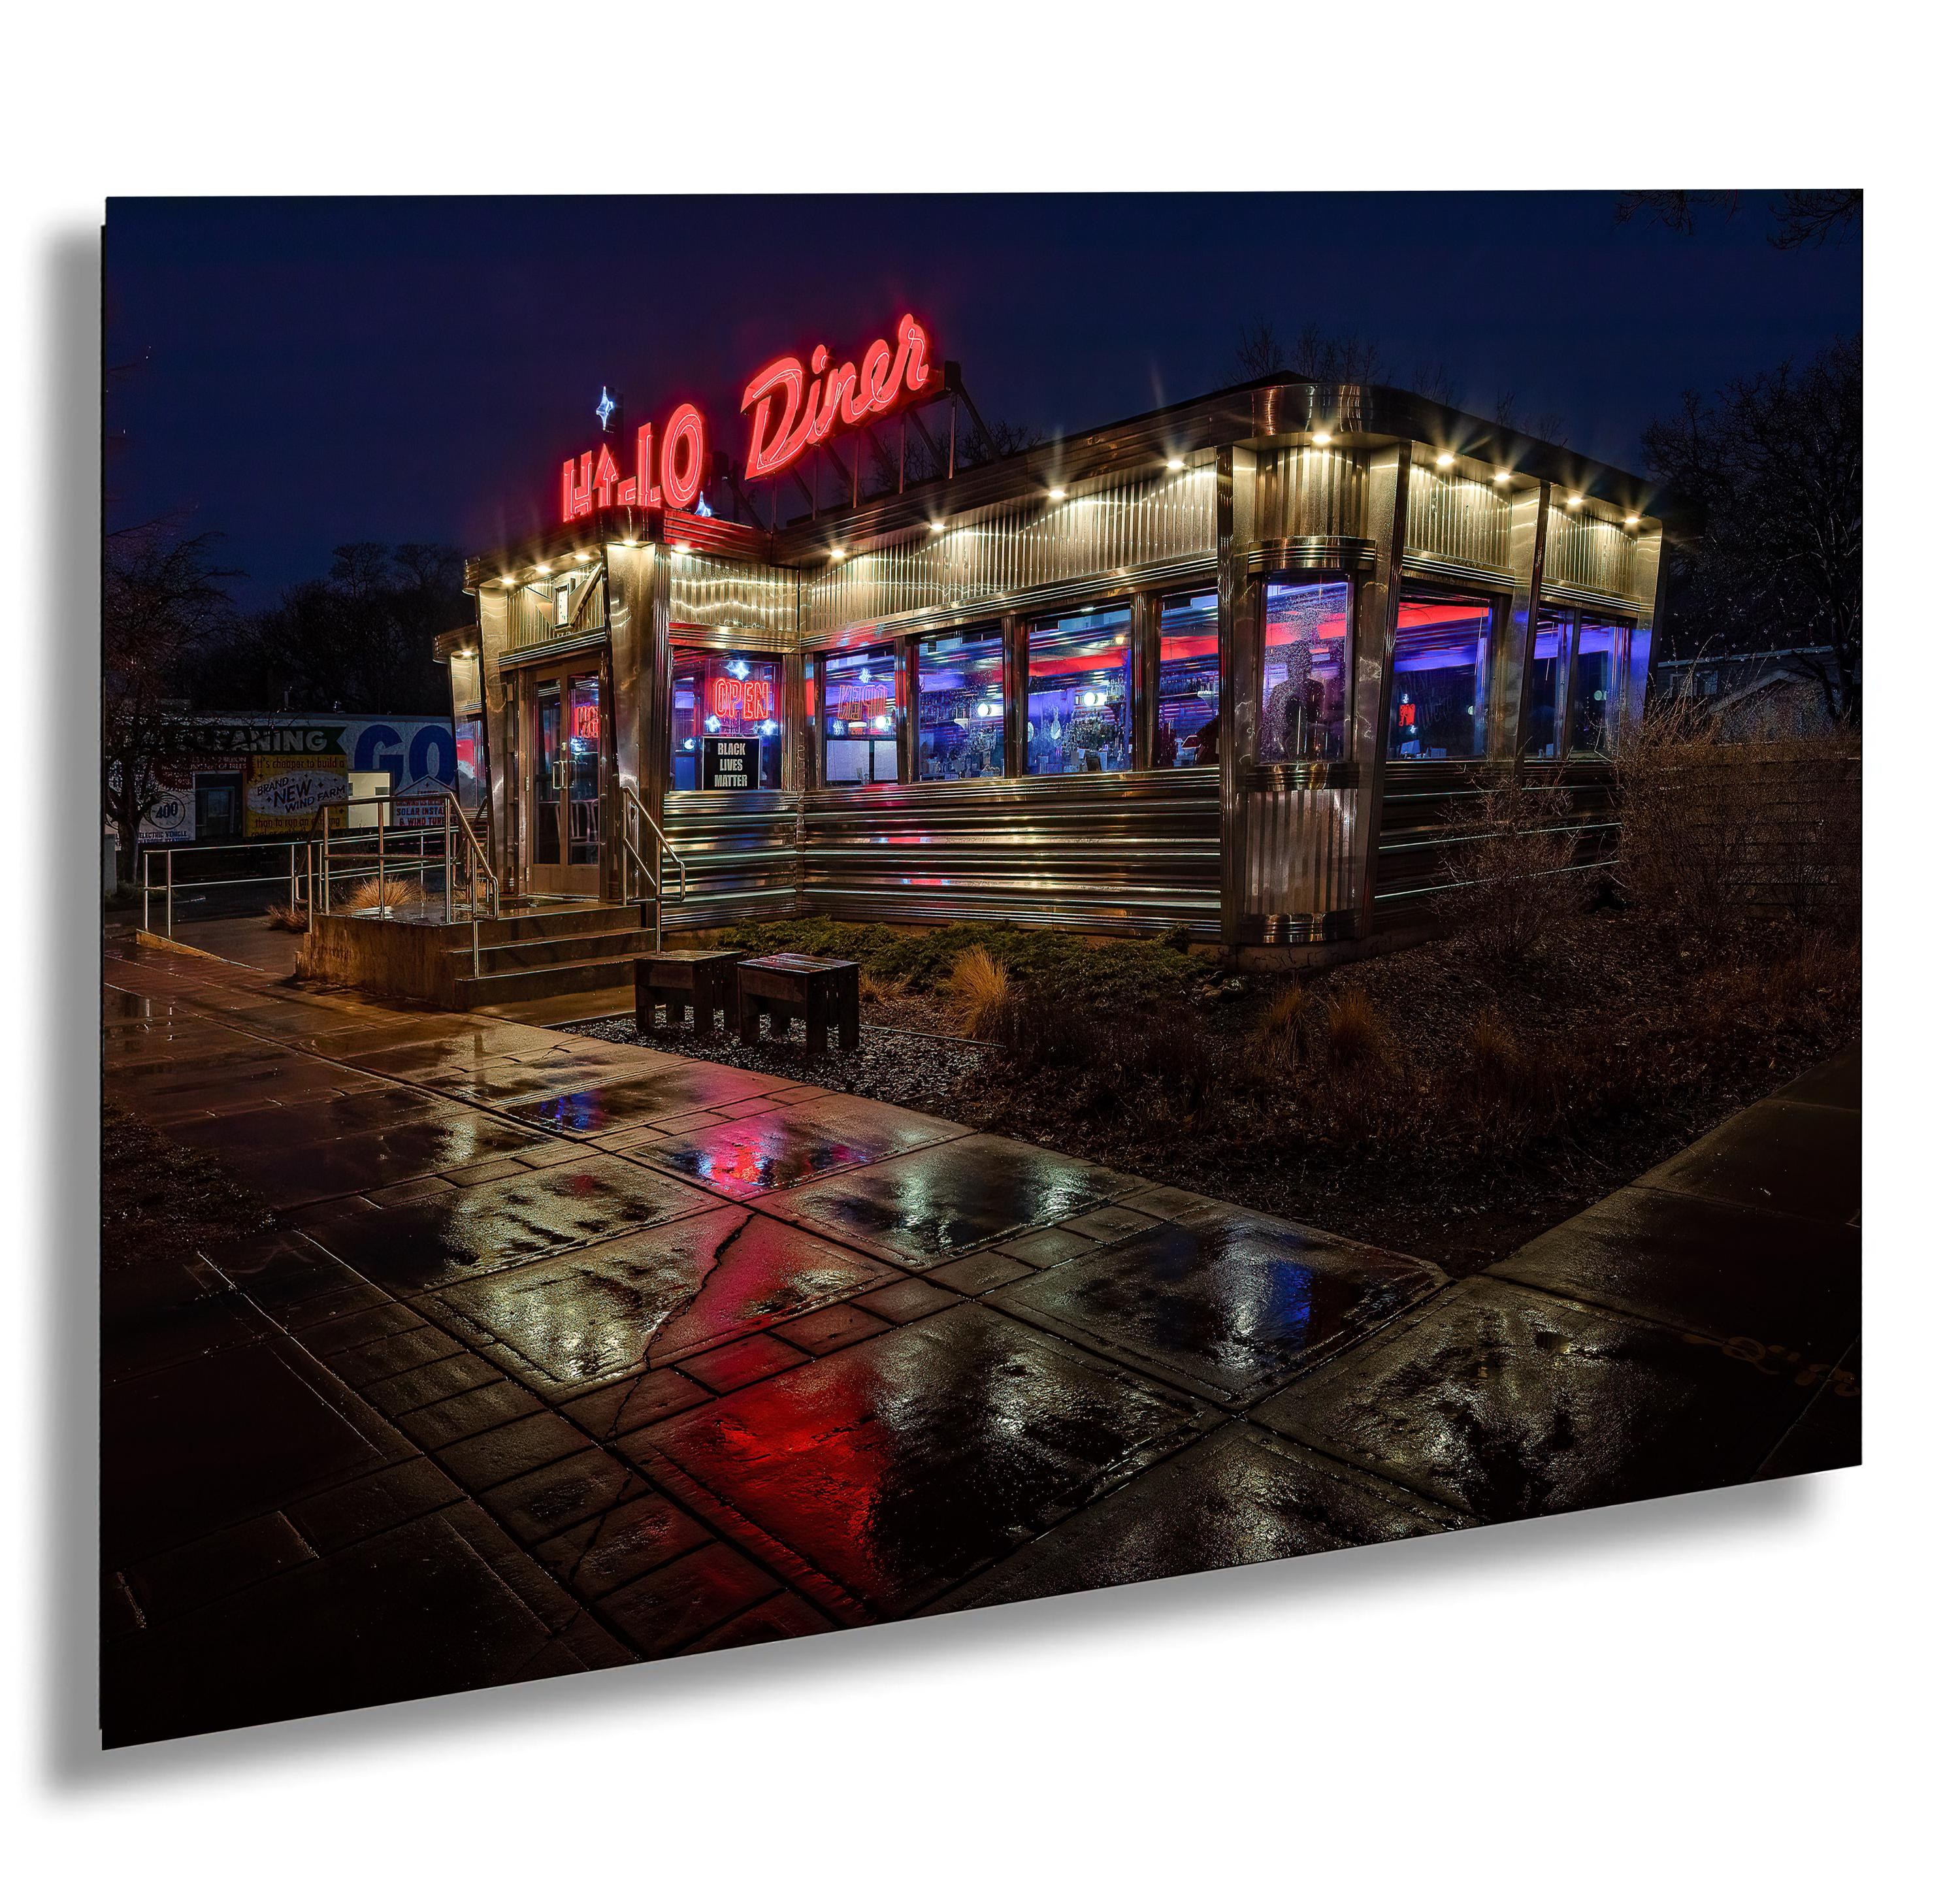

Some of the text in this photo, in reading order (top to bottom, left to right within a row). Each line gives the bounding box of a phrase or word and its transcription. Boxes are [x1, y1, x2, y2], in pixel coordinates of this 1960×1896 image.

[740, 314, 928, 480] Diner
[714, 678, 770, 720] OPEN
[717, 743, 746, 755] BLACK
[272, 757, 304, 770] cheaper
[307, 759, 314, 768] to
[318, 757, 336, 768] build
[719, 759, 743, 771] LIVES
[257, 777, 289, 796] BRAND
[714, 774, 747, 787] MATTER
[274, 779, 312, 807] NEW
[285, 785, 345, 813] WIND FARM
[155, 802, 178, 818] 400
[255, 817, 272, 827] than
[275, 818, 282, 826] to
[408, 817, 426, 826] WIND
